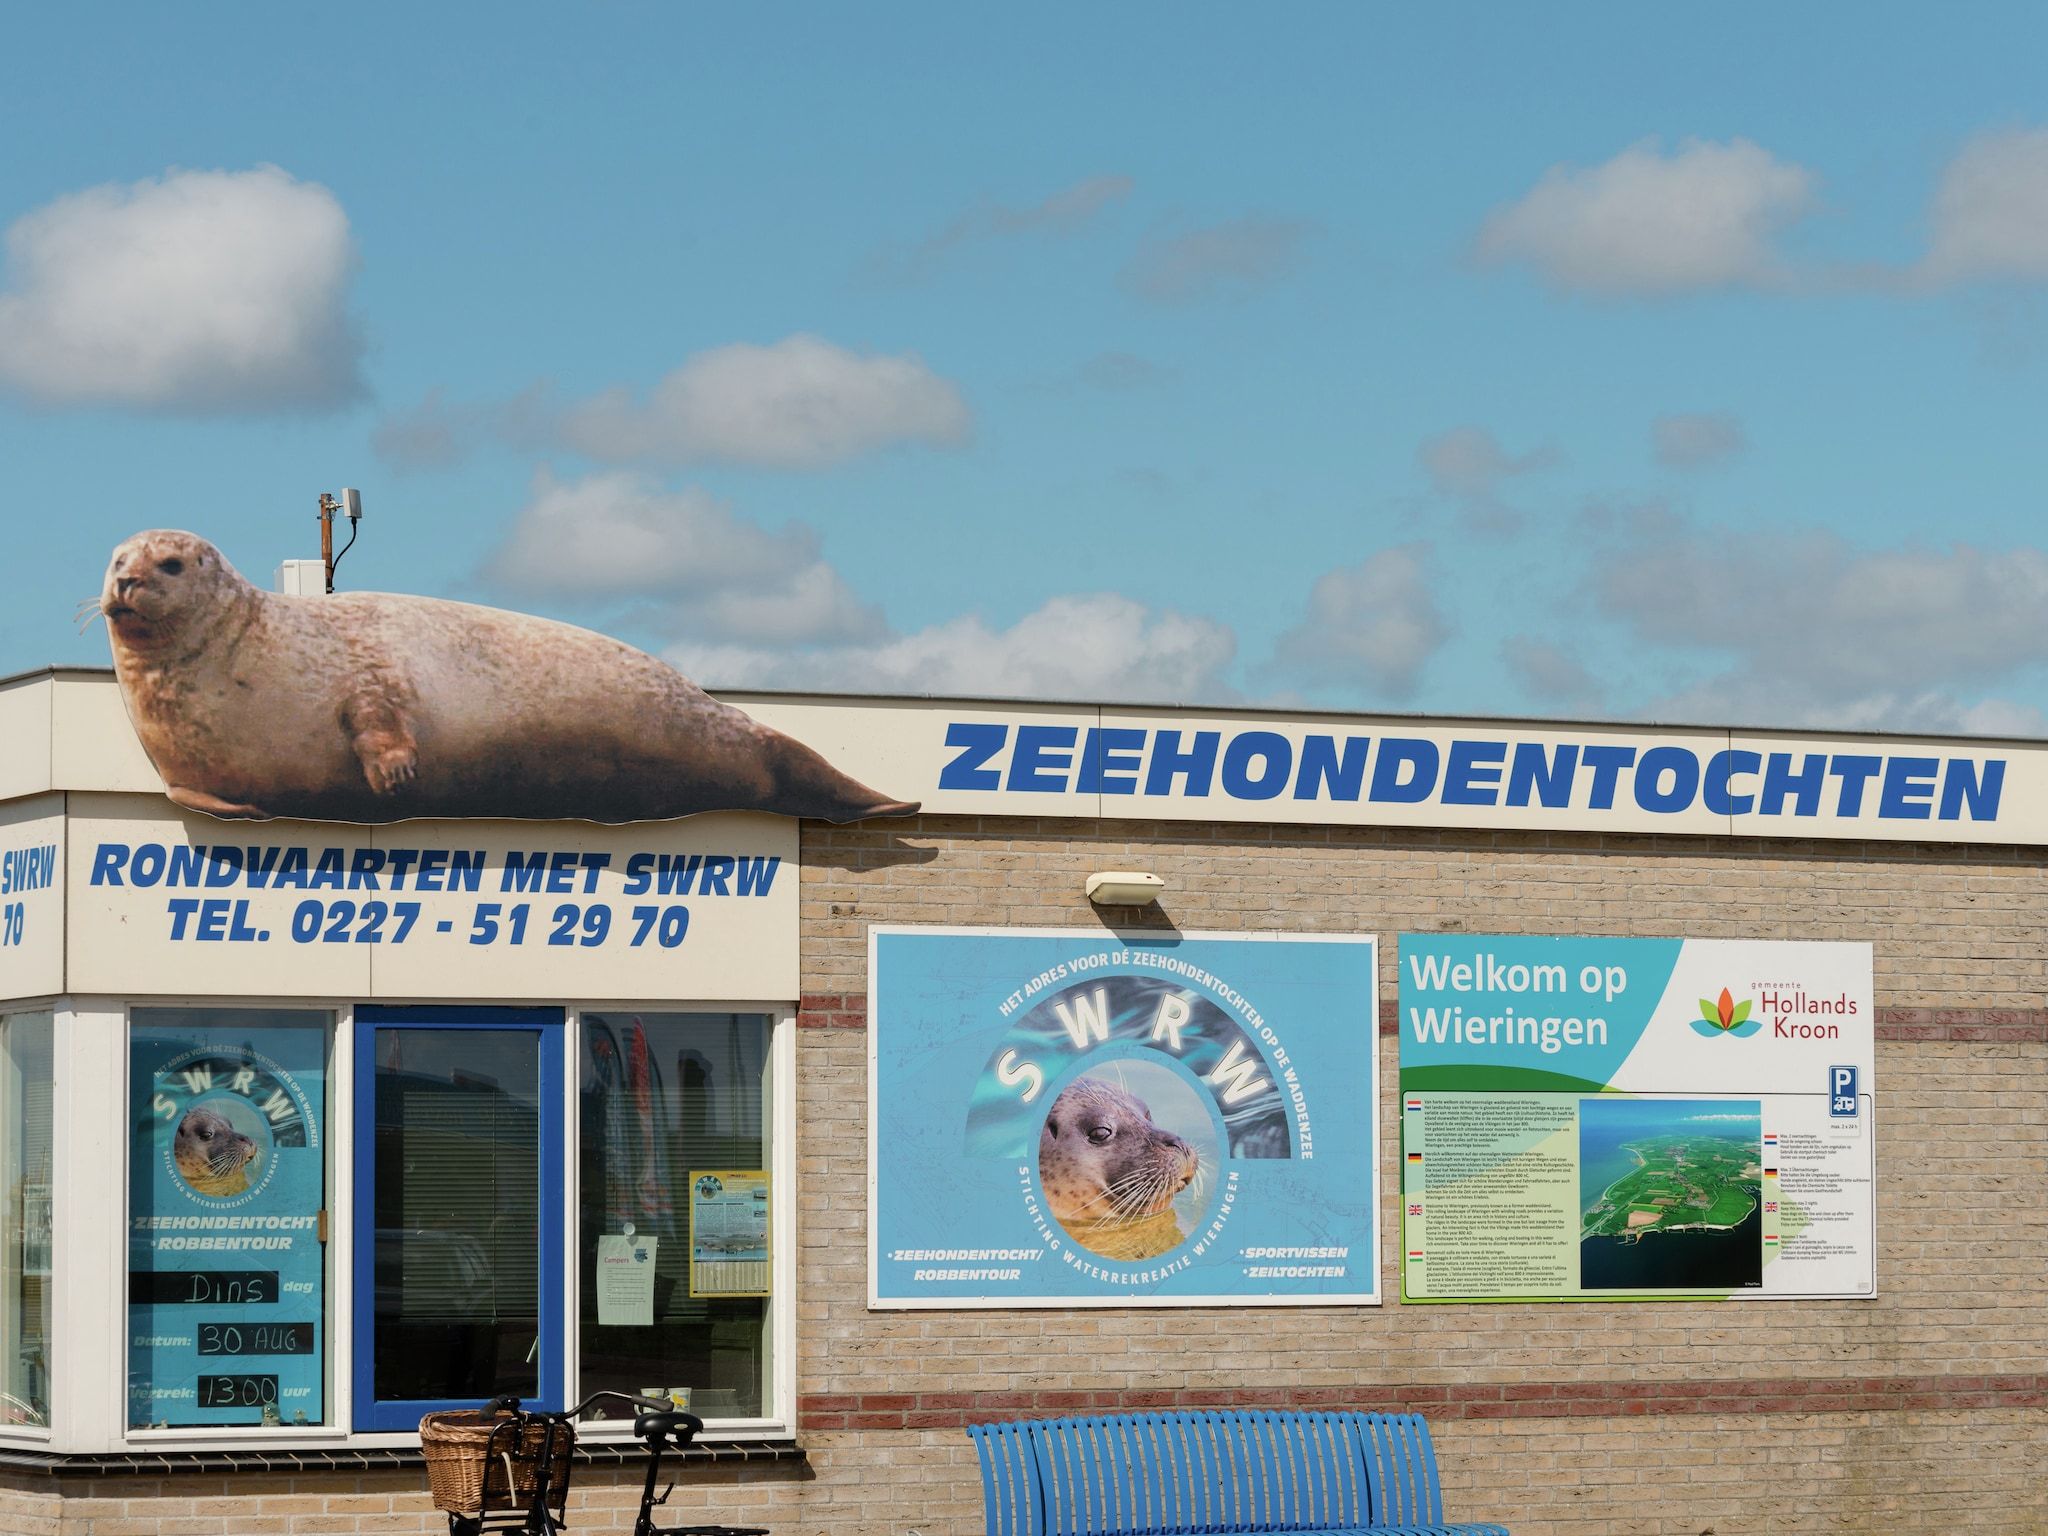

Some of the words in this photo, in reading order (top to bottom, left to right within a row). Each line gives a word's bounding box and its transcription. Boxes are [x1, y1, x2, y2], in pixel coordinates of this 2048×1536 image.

[937, 724, 2007, 823] ZEEHONDENTOCHTEN
[2, 845, 56, 894] SWRW
[90, 843, 486, 893] RONDVAARTEN
[501, 850, 607, 895] MET
[623, 854, 781, 898] SWRW
[3, 902, 24, 946] 70
[167, 899, 270, 941] TEL.
[291, 900, 421, 944] 0227
[436, 921, 452, 933] -
[470, 903, 528, 945] 51
[548, 904, 611, 947] 29
[630, 905, 690, 948] 70
[1409, 953, 1567, 993] Welkom
[1579, 963, 1628, 1003] op
[1751, 981, 1802, 990] gemeente
[1761, 991, 1857, 1016] Hollands
[1410, 1006, 1608, 1054] Wieringen
[1774, 1016, 1839, 1039] Kroon
[999, 991, 1024, 1017] HET
[1024, 964, 1068, 998] ADRES
[1069, 952, 1109, 974] VOOR
[1112, 948, 1130, 966] DÉ
[1132, 951, 1263, 1030] ZEEHONDENTOCHTEN
[1260, 1027, 1279, 1049] OP
[1273, 1048, 1290, 1069] DE
[1284, 1066, 1314, 1160] WADDENZEE
[1835, 1069, 1852, 1095] P
[303, 1101, 319, 1149] WADDENZEE
[134, 1216, 317, 1230] ZEEHONDENTOCHT
[1019, 1166, 1060, 1253] STICHTING
[1062, 1250, 1192, 1286] WATERREKREATIE
[1193, 1170, 1239, 1257] WIERINGEN
[158, 1236, 293, 1250] ROBBENTOUR
[893, 1248, 1044, 1262] ZEEHONDENTOCHT/
[1245, 1247, 1348, 1259] SPORTVISSEN
[914, 1268, 1021, 1281] ROBBENTOUR
[1248, 1266, 1346, 1278] ZEILTOCHTEN
[283, 1281, 314, 1294] dag
[133, 1336, 192, 1347] Datum:
[201, 1325, 242, 1353] 30
[255, 1327, 296, 1351] AUG
[283, 1388, 311, 1397] uur
